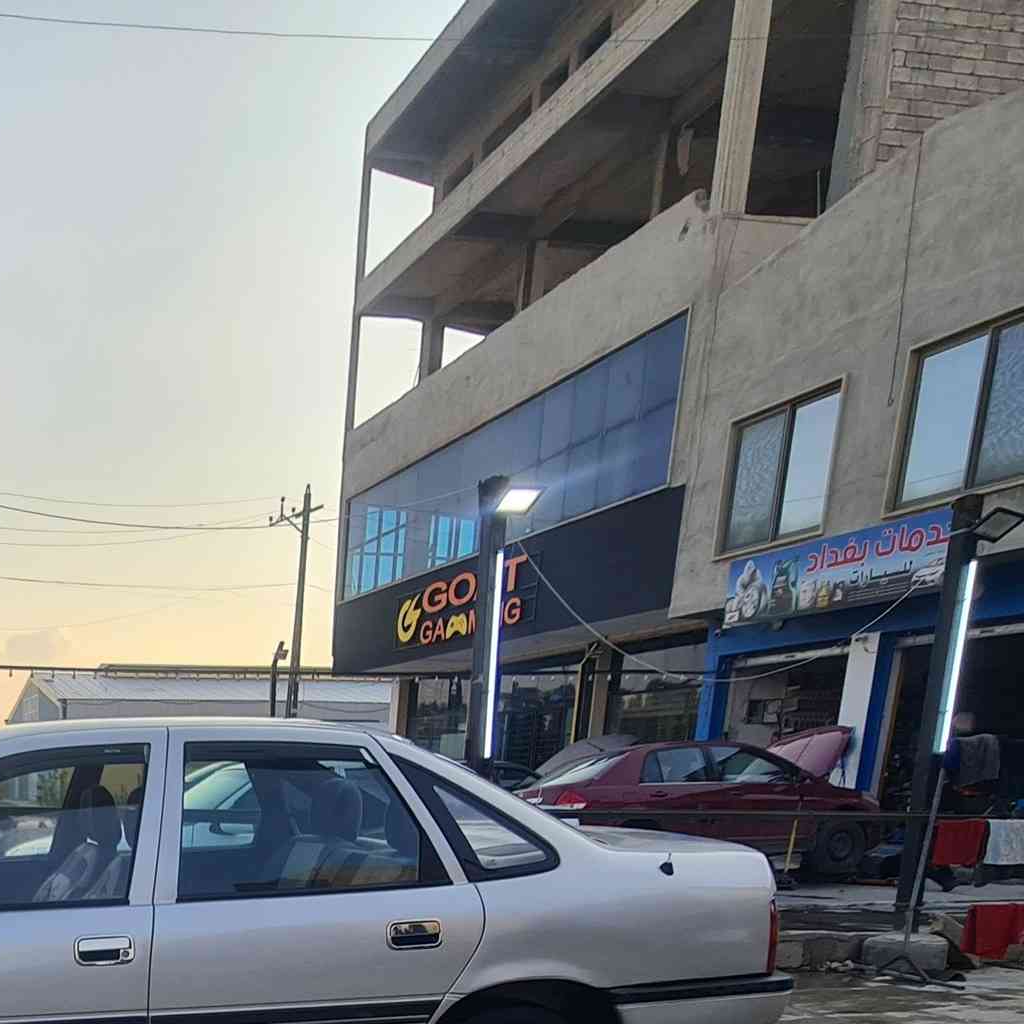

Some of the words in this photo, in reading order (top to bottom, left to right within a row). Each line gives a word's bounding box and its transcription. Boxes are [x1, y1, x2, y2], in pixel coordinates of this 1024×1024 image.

[806, 537, 870, 573] بغداد
[875, 521, 952, 558] دمات
[422, 553, 528, 614] GOT
